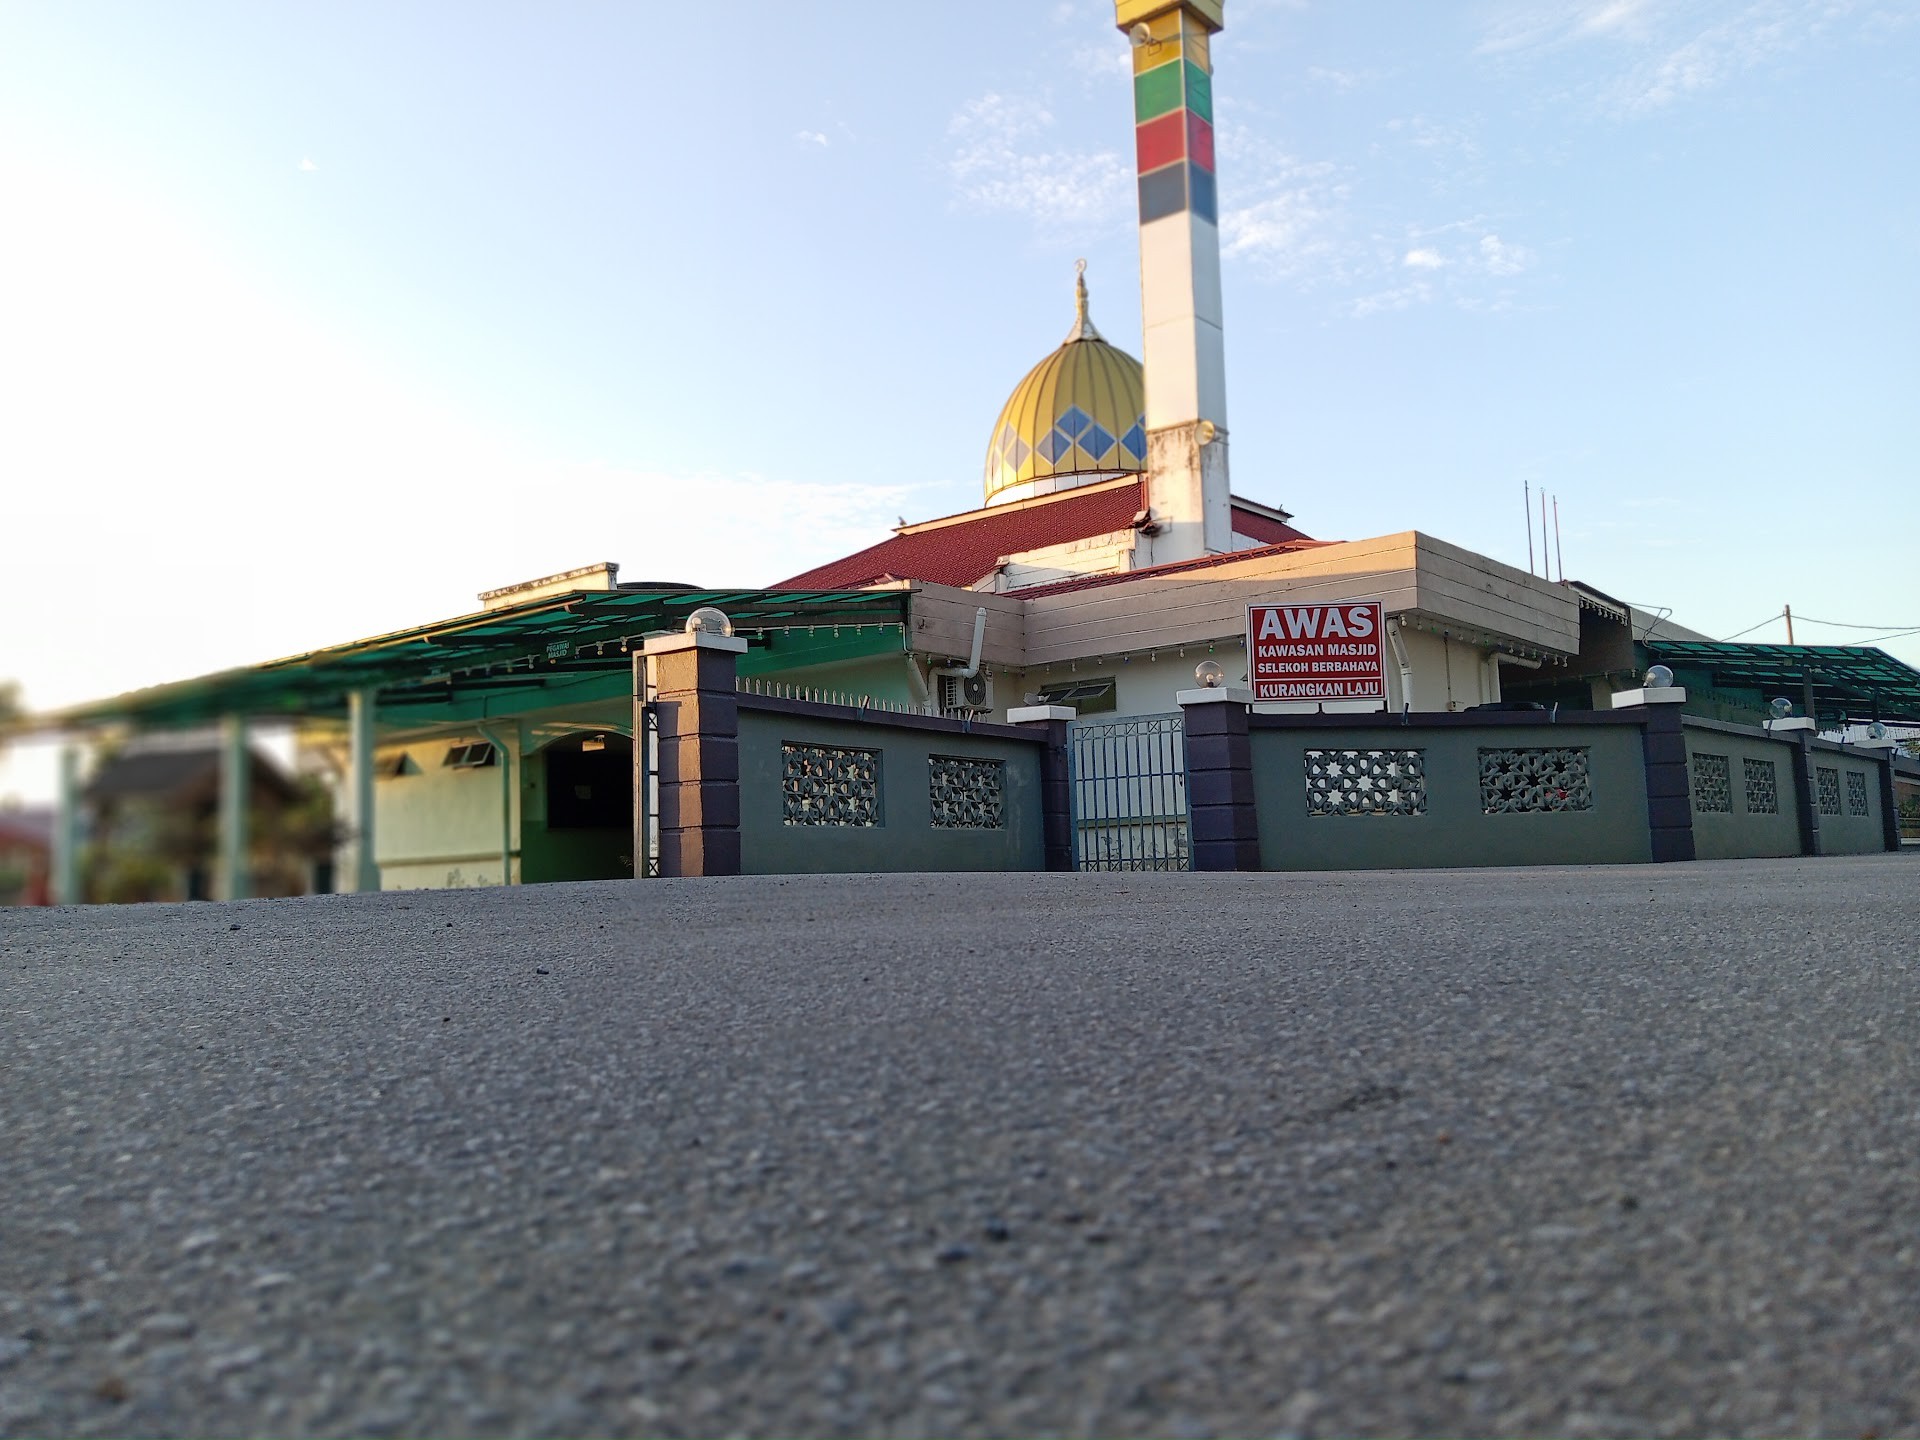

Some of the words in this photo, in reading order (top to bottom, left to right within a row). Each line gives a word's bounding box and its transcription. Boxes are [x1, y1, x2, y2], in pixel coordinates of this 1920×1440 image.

[1258, 607, 1373, 640] AWAS
[1258, 645, 1323, 657] KAWASAN
[1328, 644, 1377, 656] MASJID
[1258, 662, 1308, 673] SELEKOH
[1312, 661, 1378, 673] BERBAHAYA
[1260, 682, 1343, 697] KURANGKAN
[1347, 682, 1378, 695] LAJU
